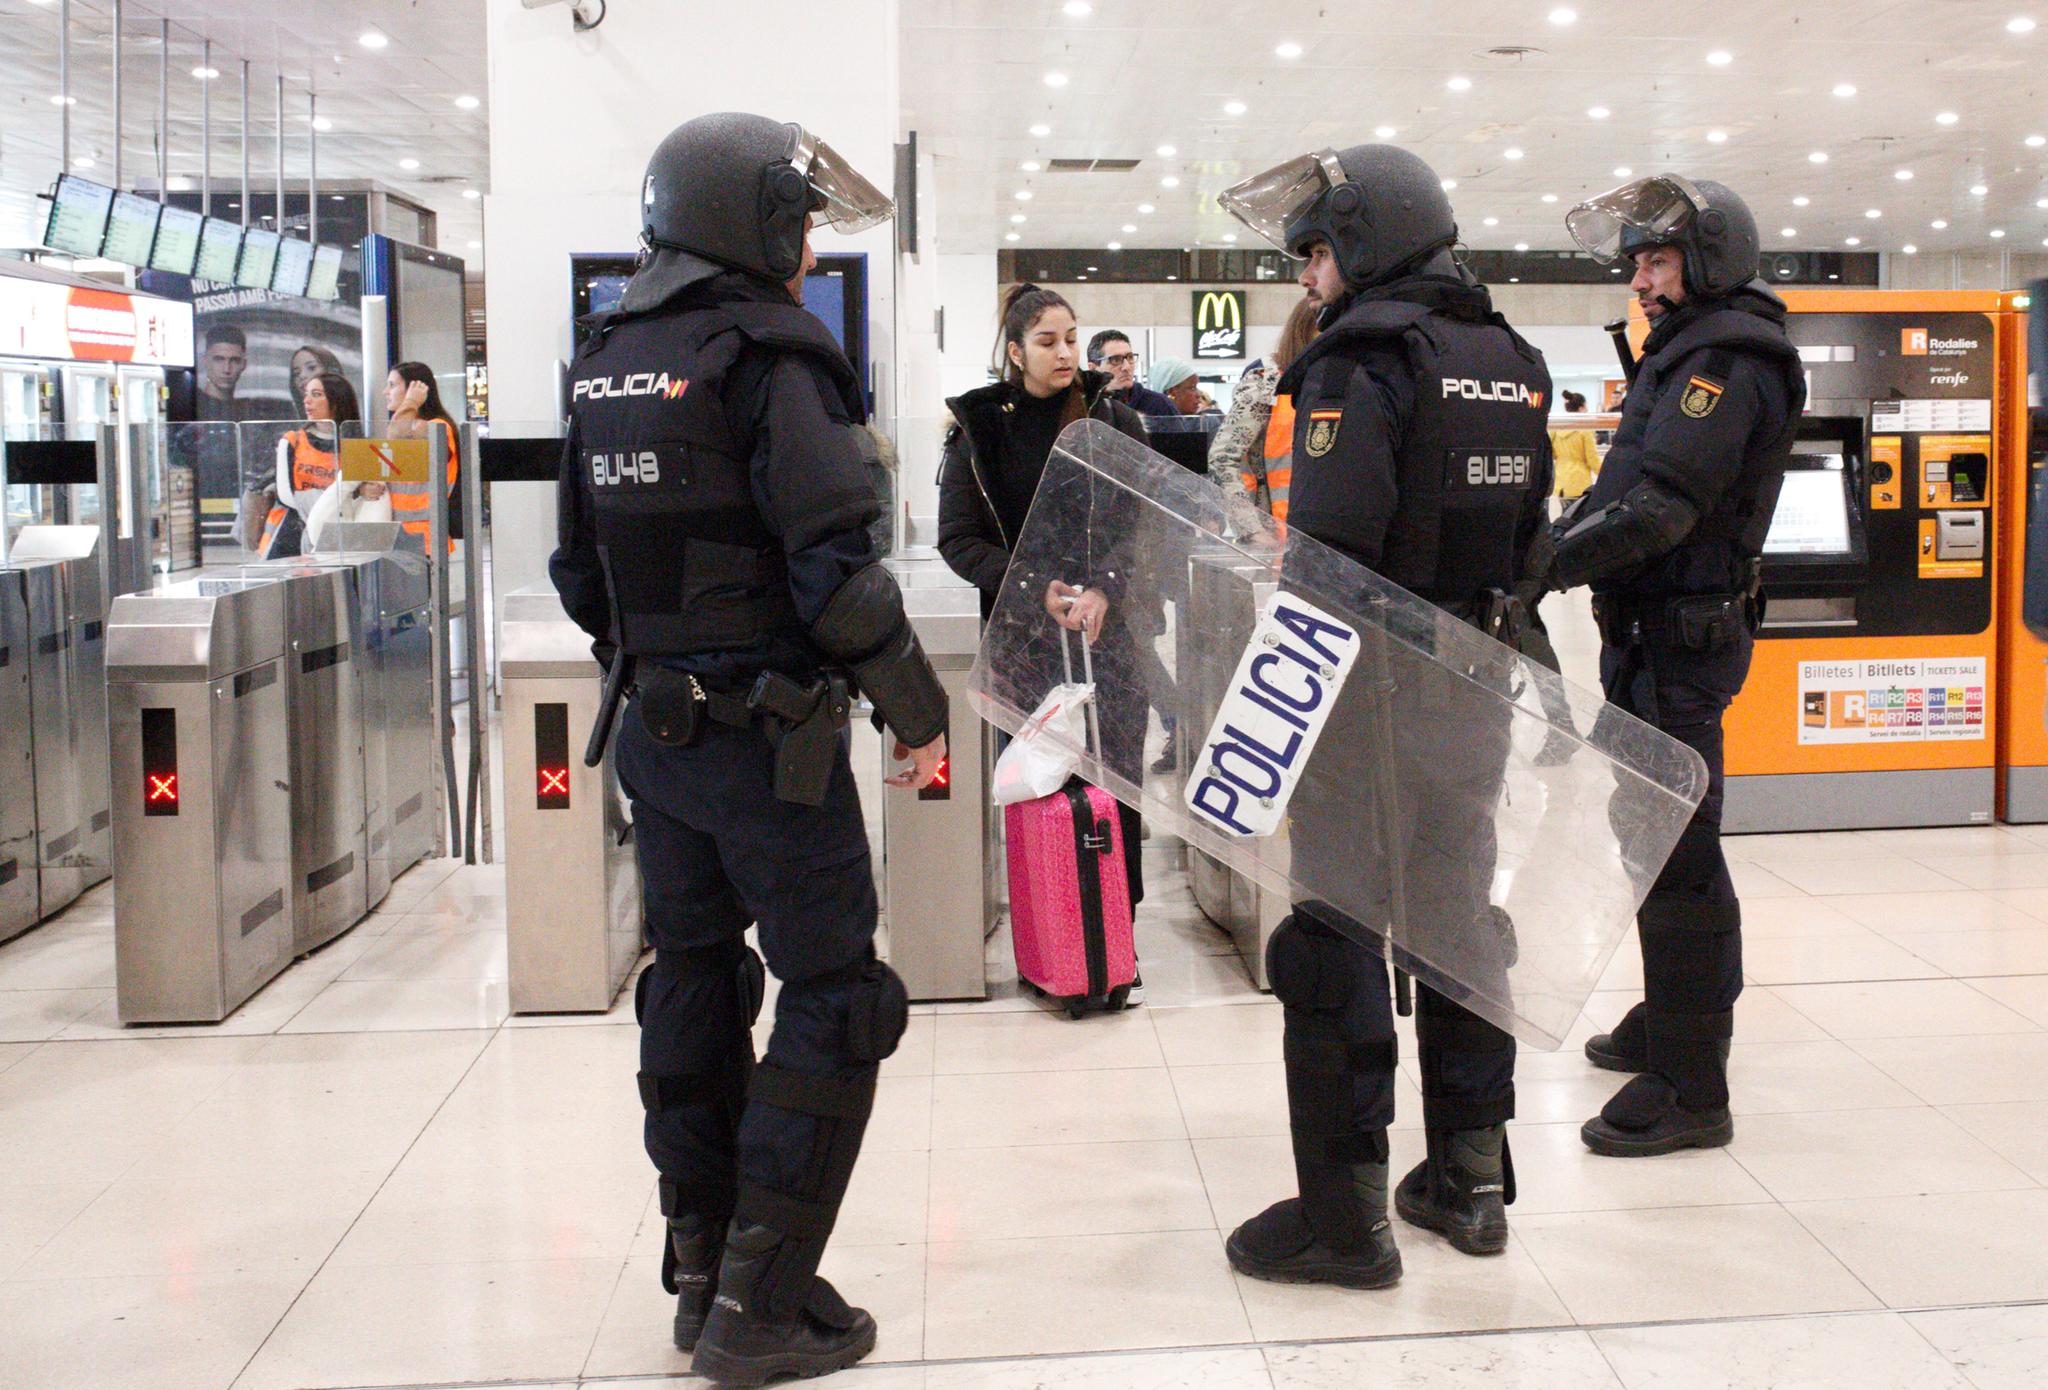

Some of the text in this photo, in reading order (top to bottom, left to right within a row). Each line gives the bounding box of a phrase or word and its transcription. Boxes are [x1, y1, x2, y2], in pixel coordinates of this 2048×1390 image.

[195, 289, 238, 313] PASSIÓ
[239, 287, 267, 306] AMB
[1911, 332, 1927, 350] R
[1929, 338, 1978, 349] Rodalies
[573, 372, 671, 402] POLICIA
[1930, 371, 1969, 388] renfe
[1442, 378, 1533, 405] POLICIA
[1804, 664, 1977, 679] Billetes Bitllets TICKETS SALE
[1870, 693, 1884, 704] R1
[1888, 692, 1904, 704] R2
[1907, 692, 1923, 703] R3
[1929, 693, 1945, 702] R11
[1947, 692, 1964, 701] R12
[1191, 604, 1353, 835] POLICIA
[1869, 713, 1885, 724] R4
[1888, 712, 1904, 723] R7
[1907, 711, 1923, 723] R8
[1929, 712, 1945, 721] R14
[1948, 711, 1964, 720] R15
[1966, 711, 1982, 720] R16
